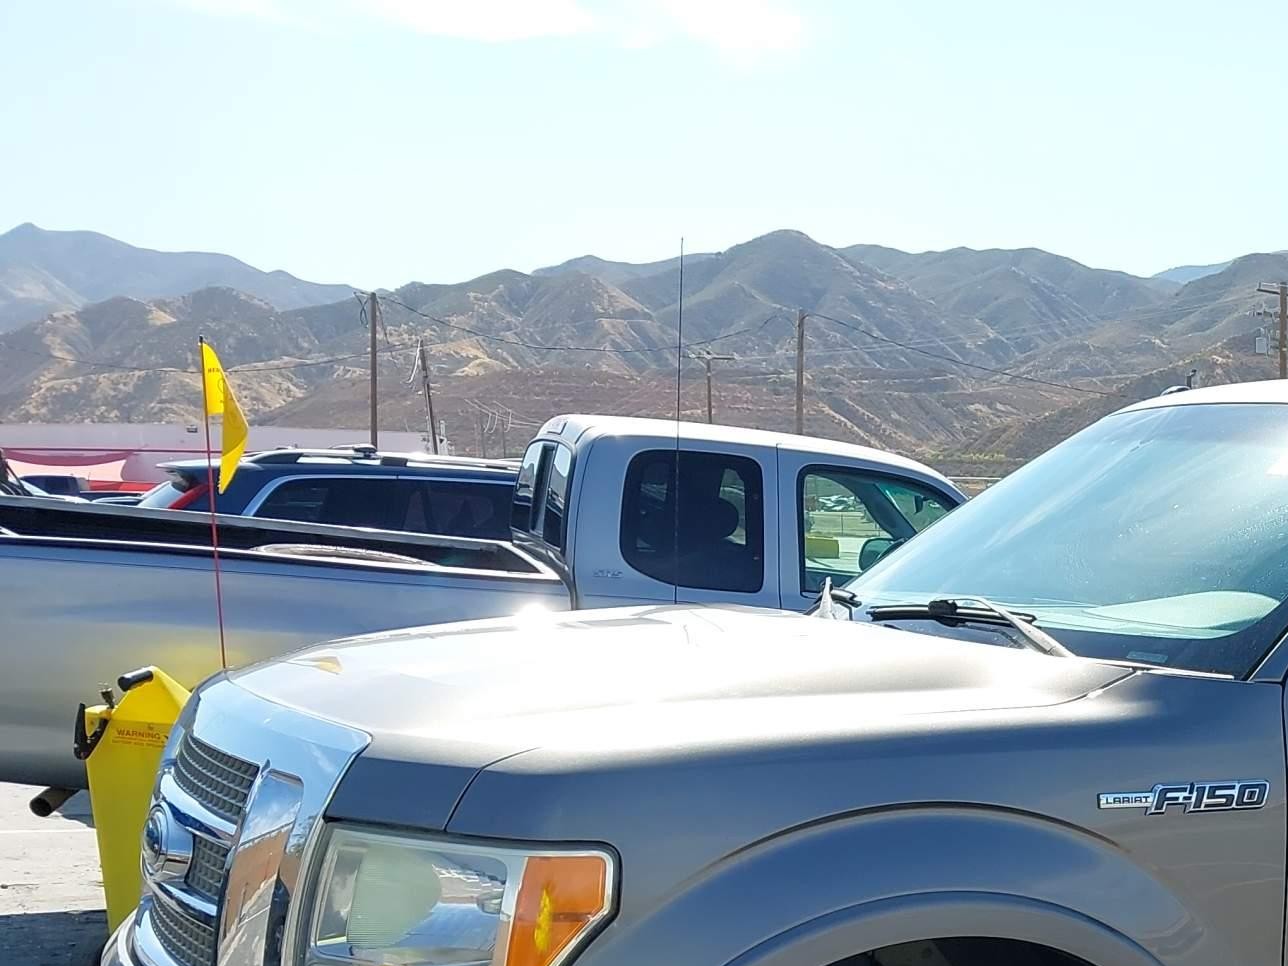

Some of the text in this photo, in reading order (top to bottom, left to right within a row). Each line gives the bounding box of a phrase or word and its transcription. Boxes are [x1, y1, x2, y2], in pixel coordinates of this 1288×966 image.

[116, 728, 161, 740] WARNING
[1105, 780, 1270, 815] LARIAT F-150
